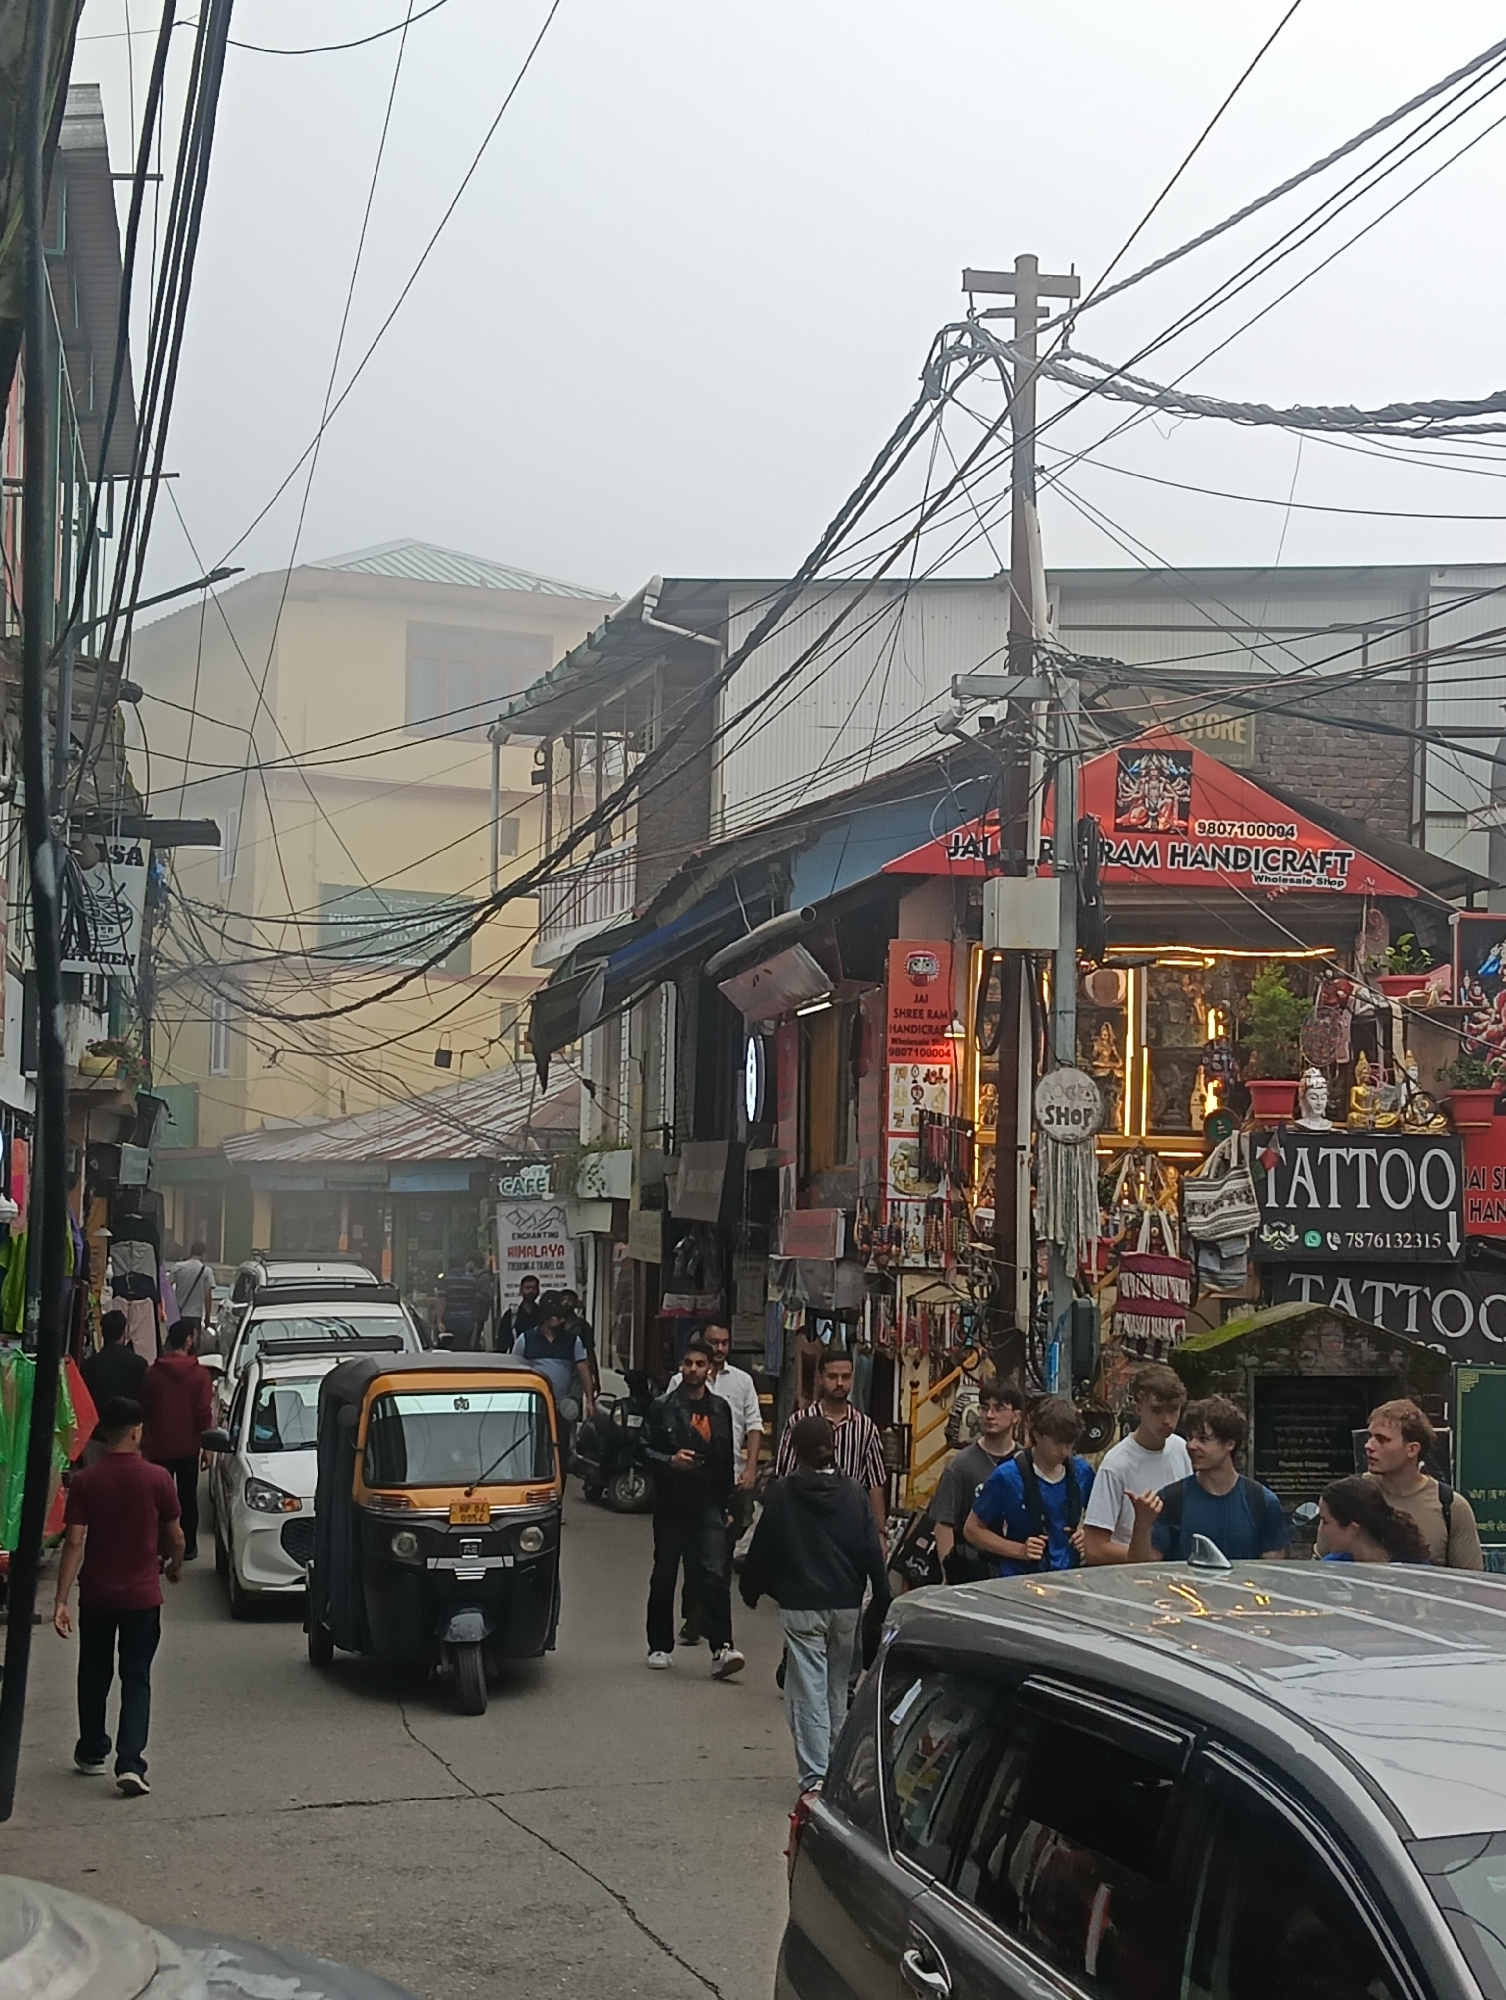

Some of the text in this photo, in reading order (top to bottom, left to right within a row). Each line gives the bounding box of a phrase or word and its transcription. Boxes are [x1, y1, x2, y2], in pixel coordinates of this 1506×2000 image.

[1180, 713, 1246, 745] STORE
[1195, 819, 1298, 840] 9807100004
[947, 832, 991, 862] JAI
[1099, 839, 1161, 868] RAM
[1167, 842, 1355, 876] HANDICRAFT
[1252, 874, 1347, 890] Wholesale Shop
[913, 993, 929, 1004] JAI
[893, 1007, 949, 1020] SHREE RAM
[888, 1023, 948, 1036] HANDICRAF
[888, 1046, 952, 1059] 9807100004
[1044, 1104, 1094, 1128] SHOP
[500, 1176, 548, 1195] CAFE
[1256, 1147, 1457, 1211] TATTOO
[511, 1231, 560, 1240] ENCHANTING
[1345, 1231, 1443, 1249] 7876132315
[507, 1244, 565, 1258] HIMALAYA
[1287, 1272, 1506, 1343] TATTOO
